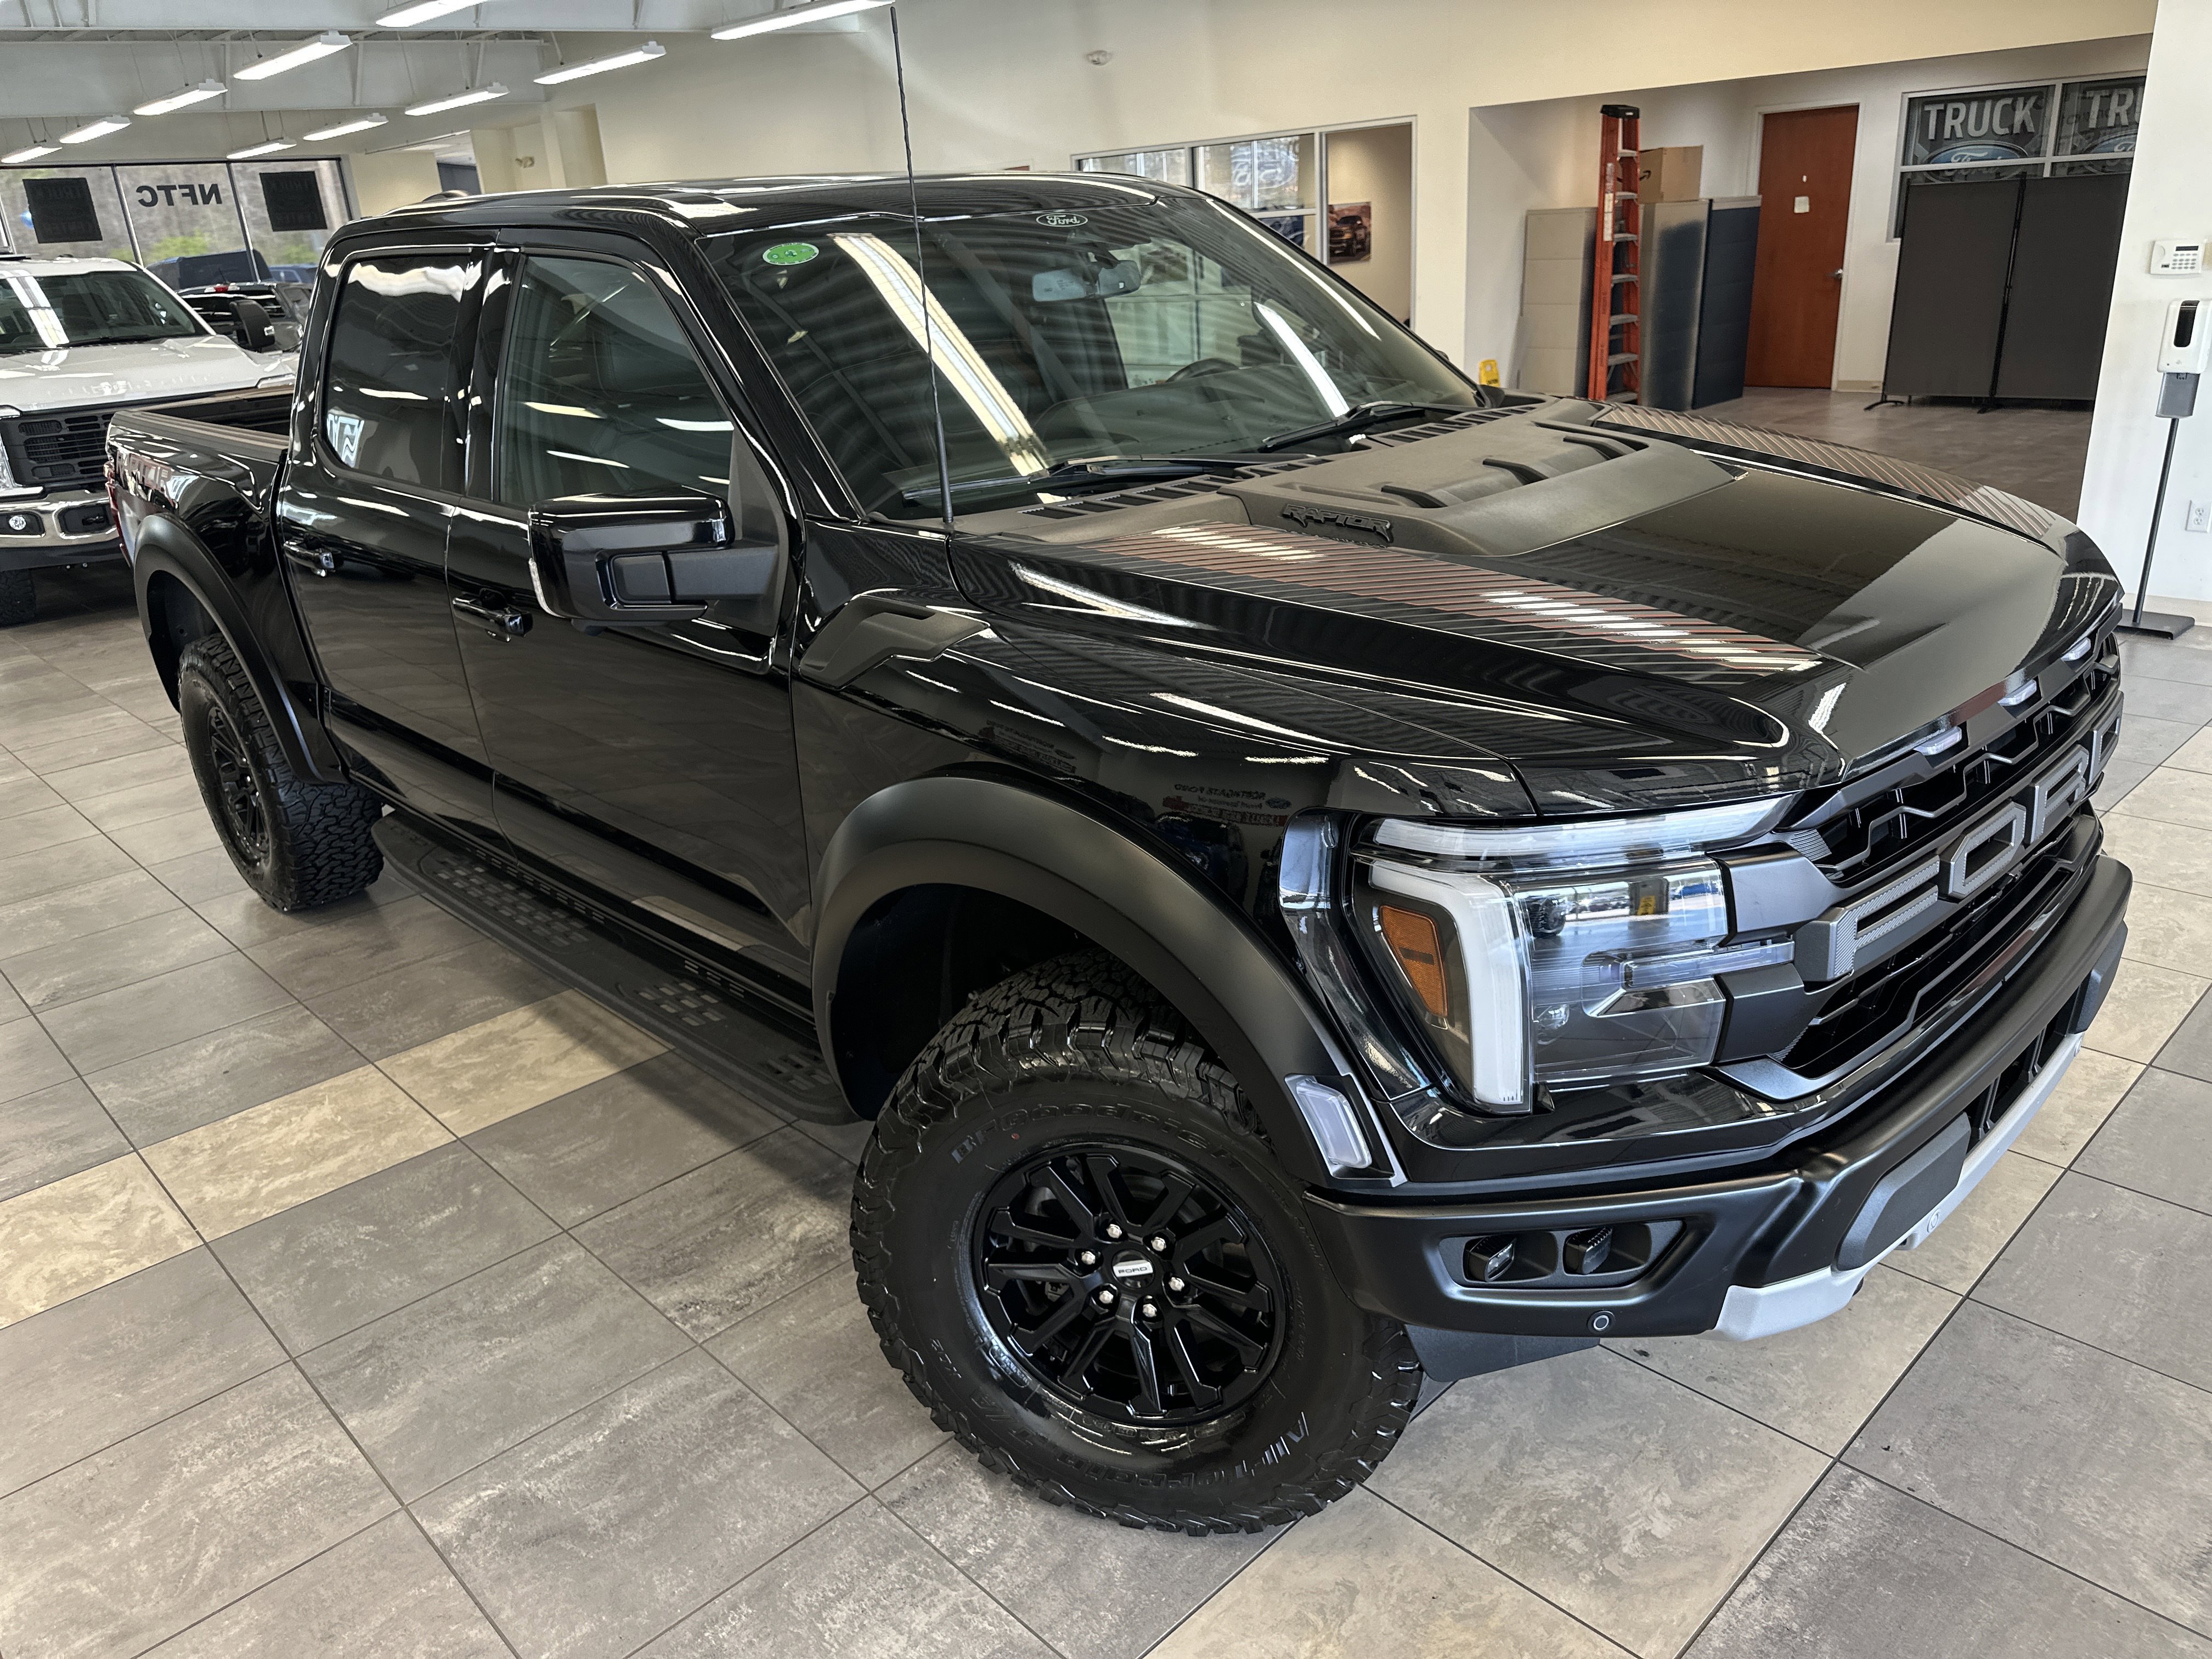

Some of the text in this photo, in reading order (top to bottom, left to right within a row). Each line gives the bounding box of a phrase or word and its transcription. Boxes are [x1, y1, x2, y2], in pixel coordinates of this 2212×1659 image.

[1924, 95, 2035, 140] TRUCK
[1046, 215, 1080, 225] Ford
[1282, 504, 1393, 543] RAPTOR
[1828, 692, 2124, 982] FORD
